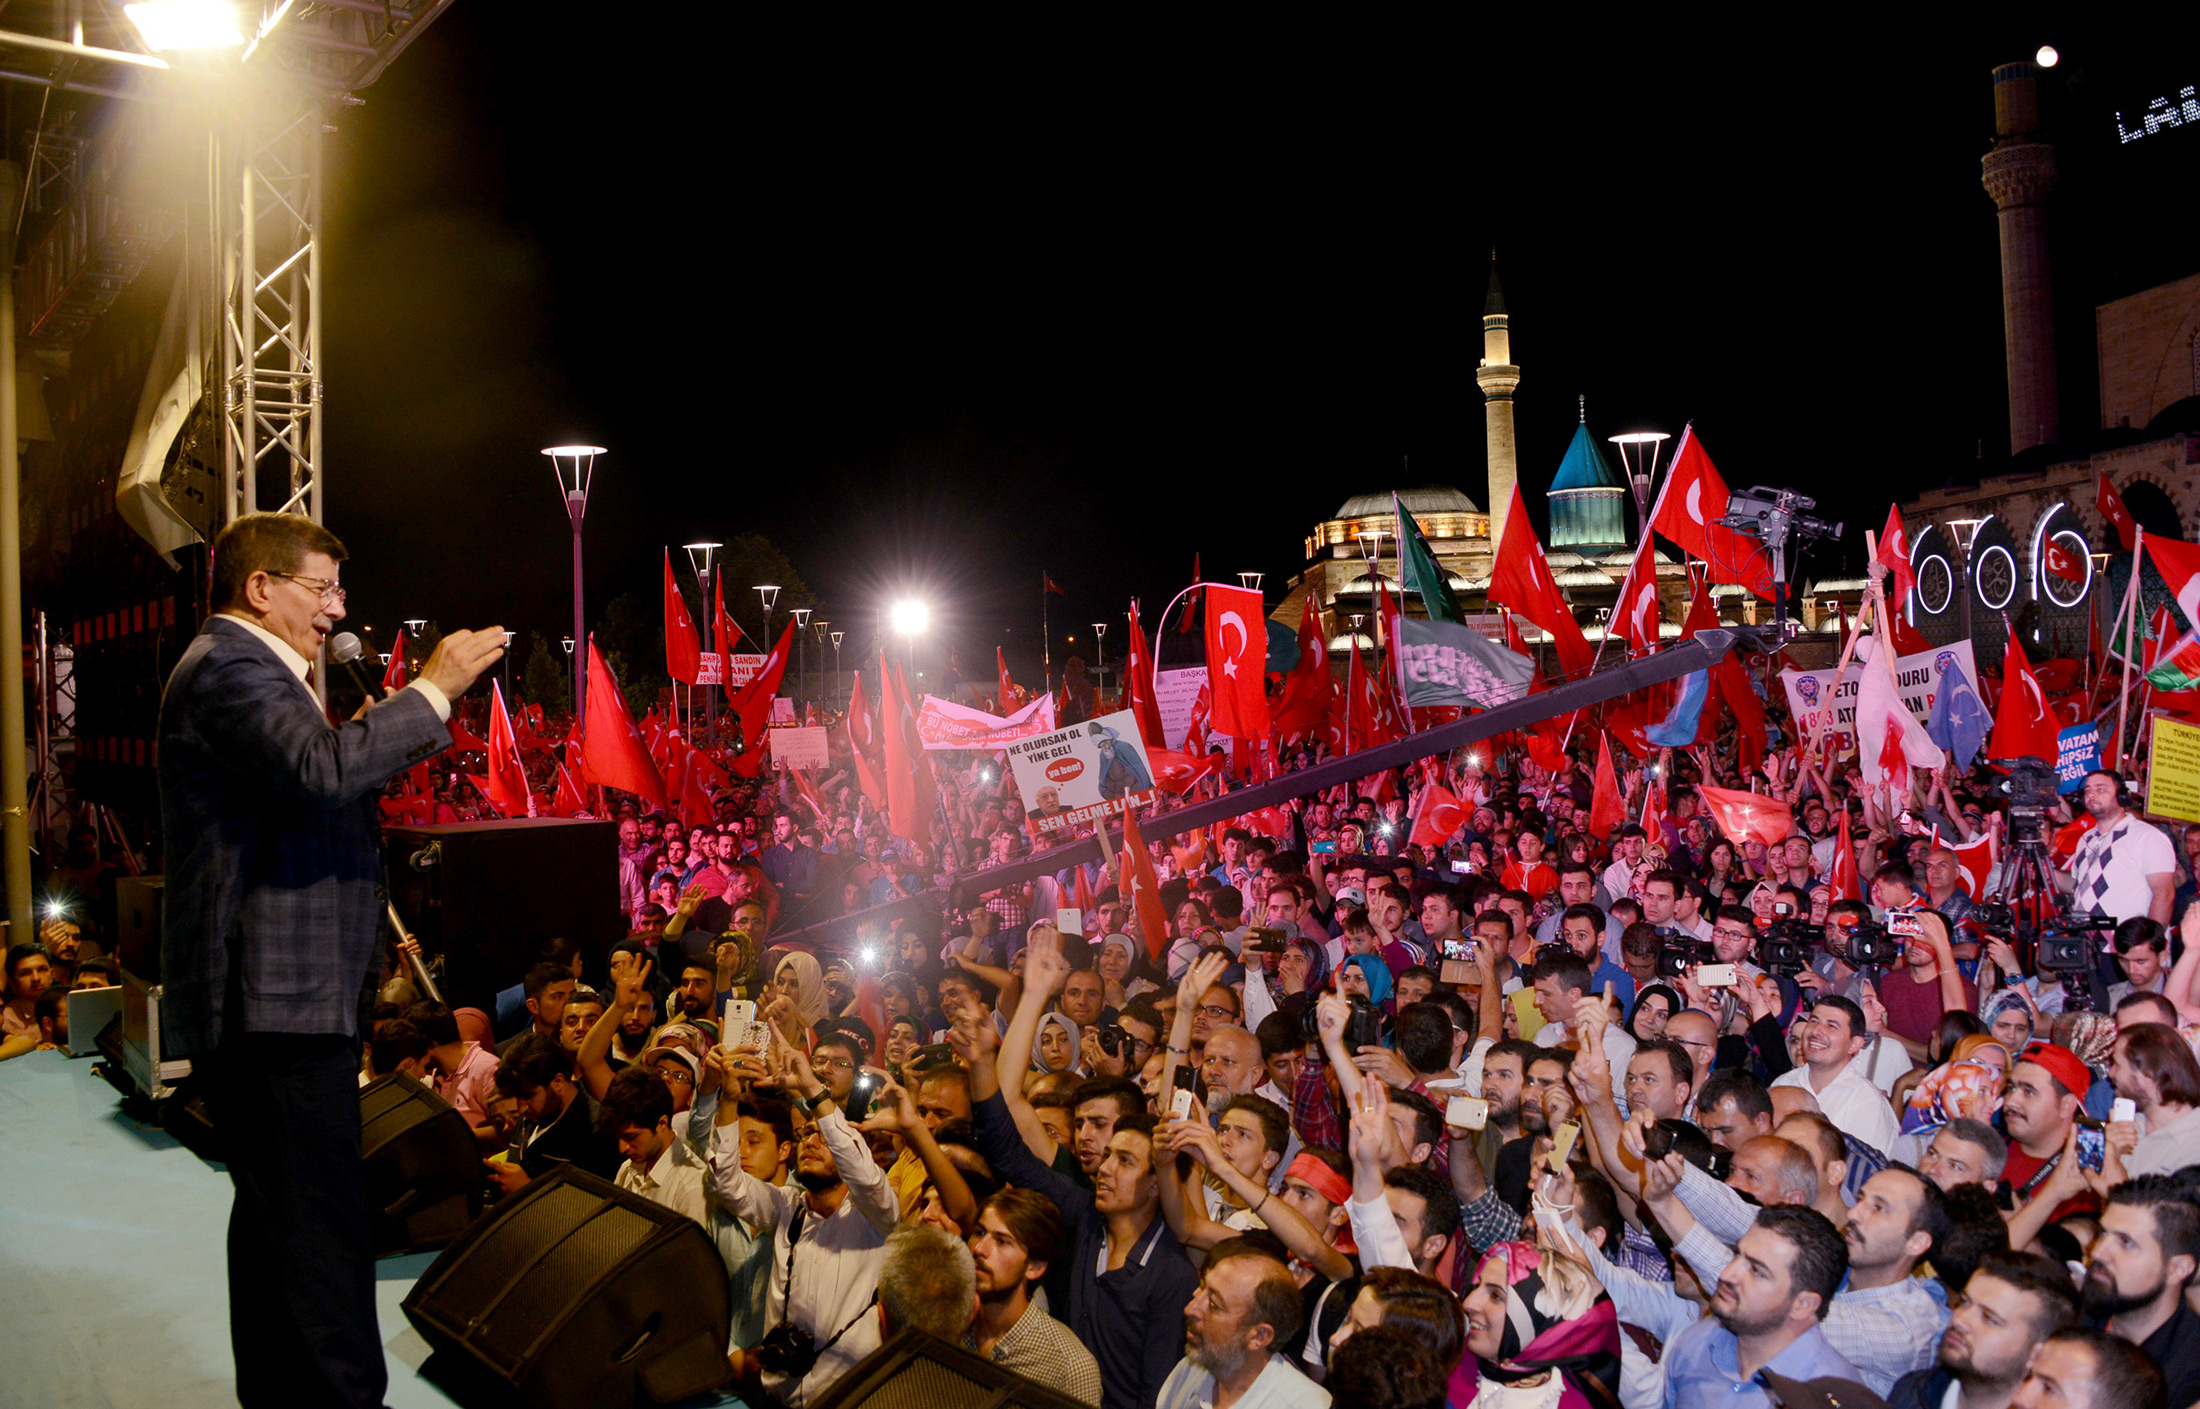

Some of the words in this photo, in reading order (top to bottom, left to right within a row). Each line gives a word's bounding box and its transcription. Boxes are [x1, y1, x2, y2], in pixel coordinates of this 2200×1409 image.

[1180, 670, 1206, 678] BAŞKA
[926, 716, 940, 729] BU
[940, 720, 971, 737] NÖBET
[1009, 743, 1022, 756] NE
[1022, 733, 1068, 753] OLURSAN
[1069, 728, 1082, 740] OL
[1027, 749, 1051, 764] YİNE
[1047, 769, 1060, 780] ya
[1060, 761, 1083, 776] ben!
[1038, 814, 1065, 832] SEN
[1066, 800, 1113, 825] GELME
